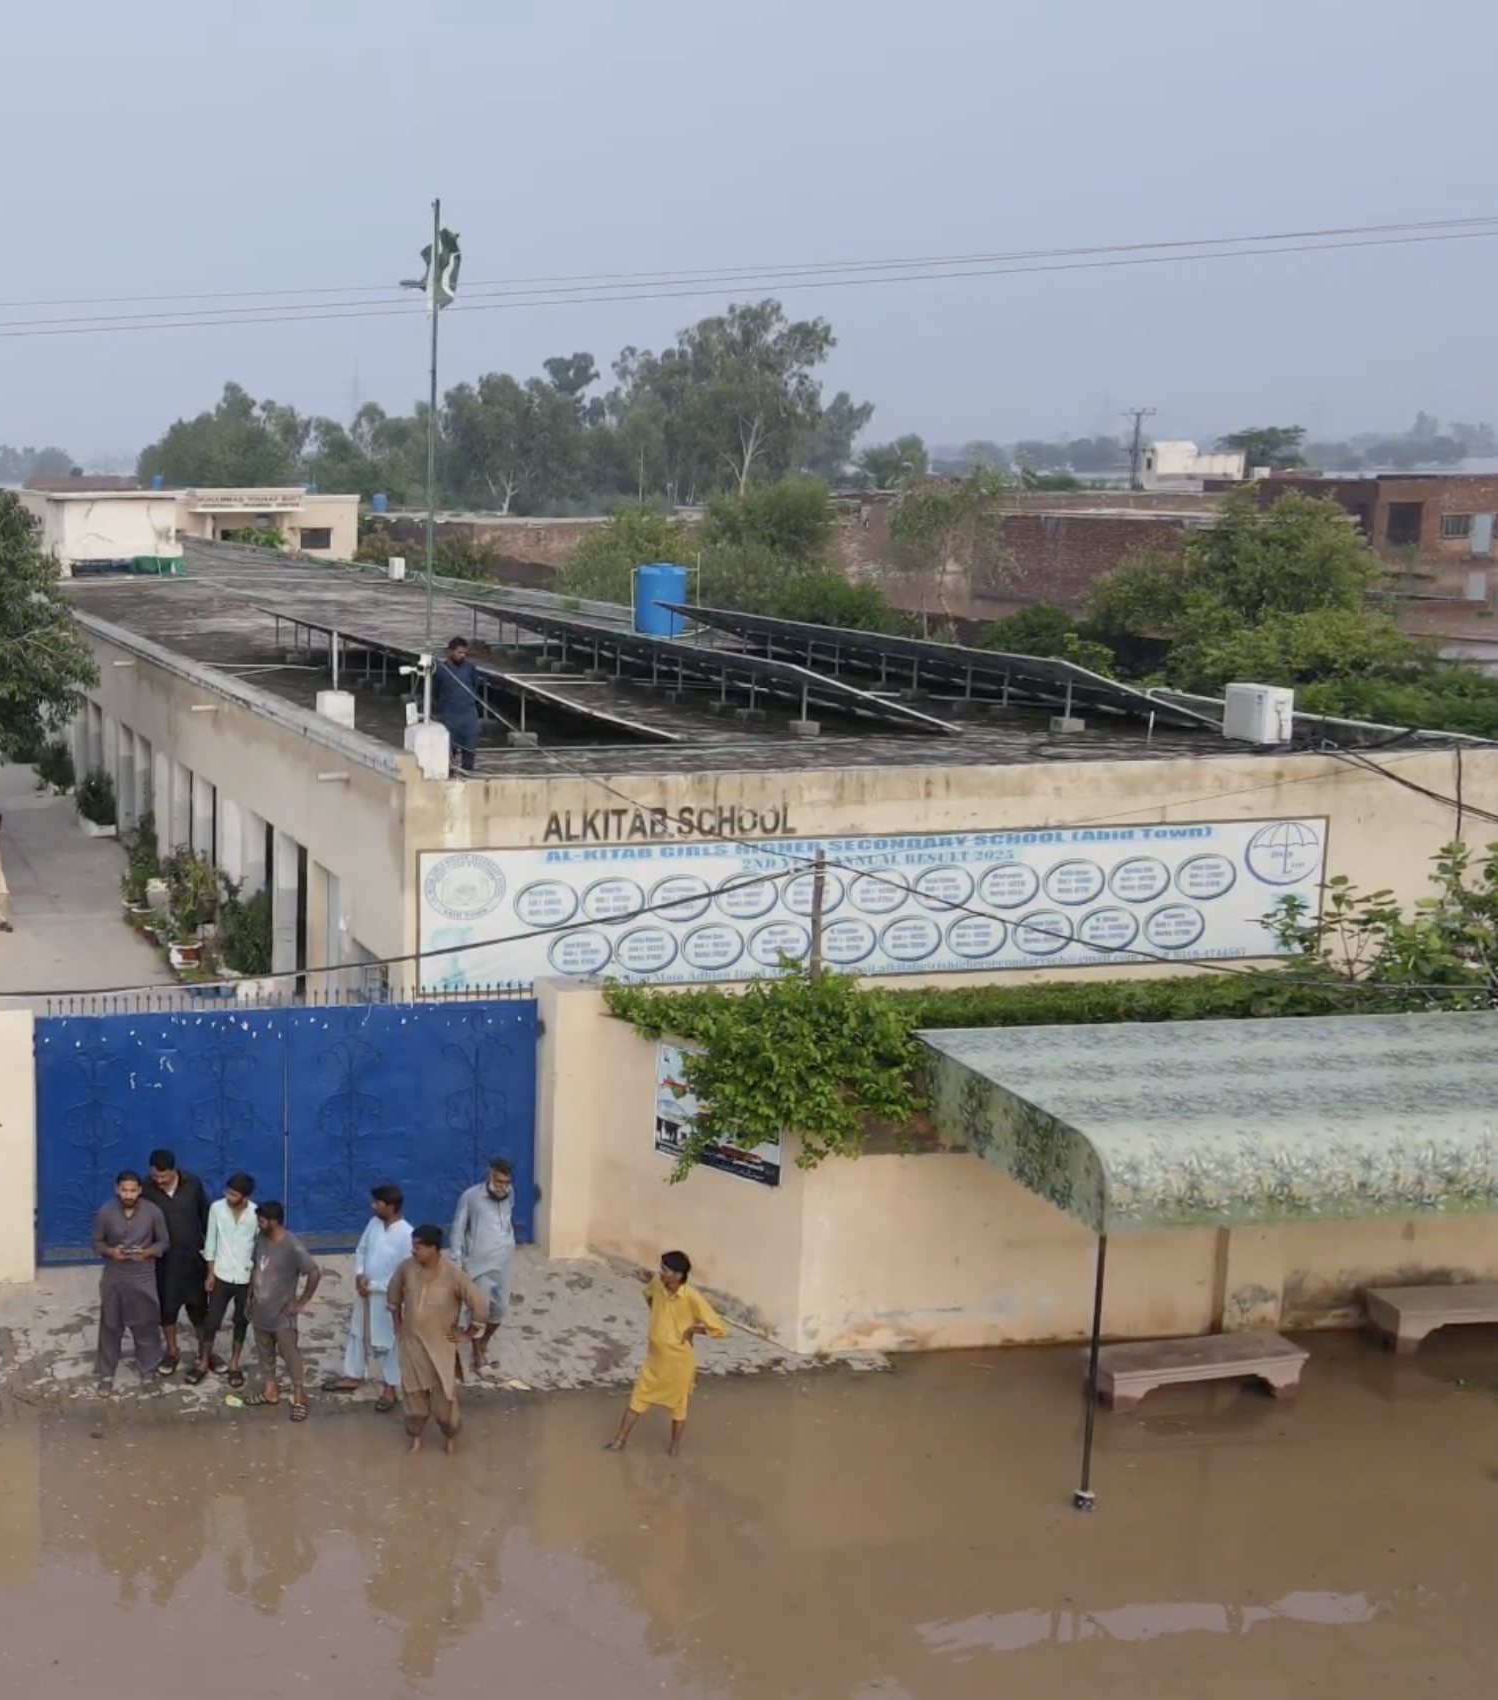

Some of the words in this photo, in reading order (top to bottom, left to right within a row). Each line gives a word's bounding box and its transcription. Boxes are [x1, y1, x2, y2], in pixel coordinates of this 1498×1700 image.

[543, 807, 670, 841] ALKITAB
[677, 802, 796, 839] SCHOOL
[546, 848, 652, 862] AL-KITAB
[660, 844, 728, 858] GIRLS
[735, 841, 823, 855] HIGHER
[829, 835, 966, 850] SECONDARY
[974, 831, 1064, 845] SCHOOL
[1143, 825, 1212, 837] Town)
